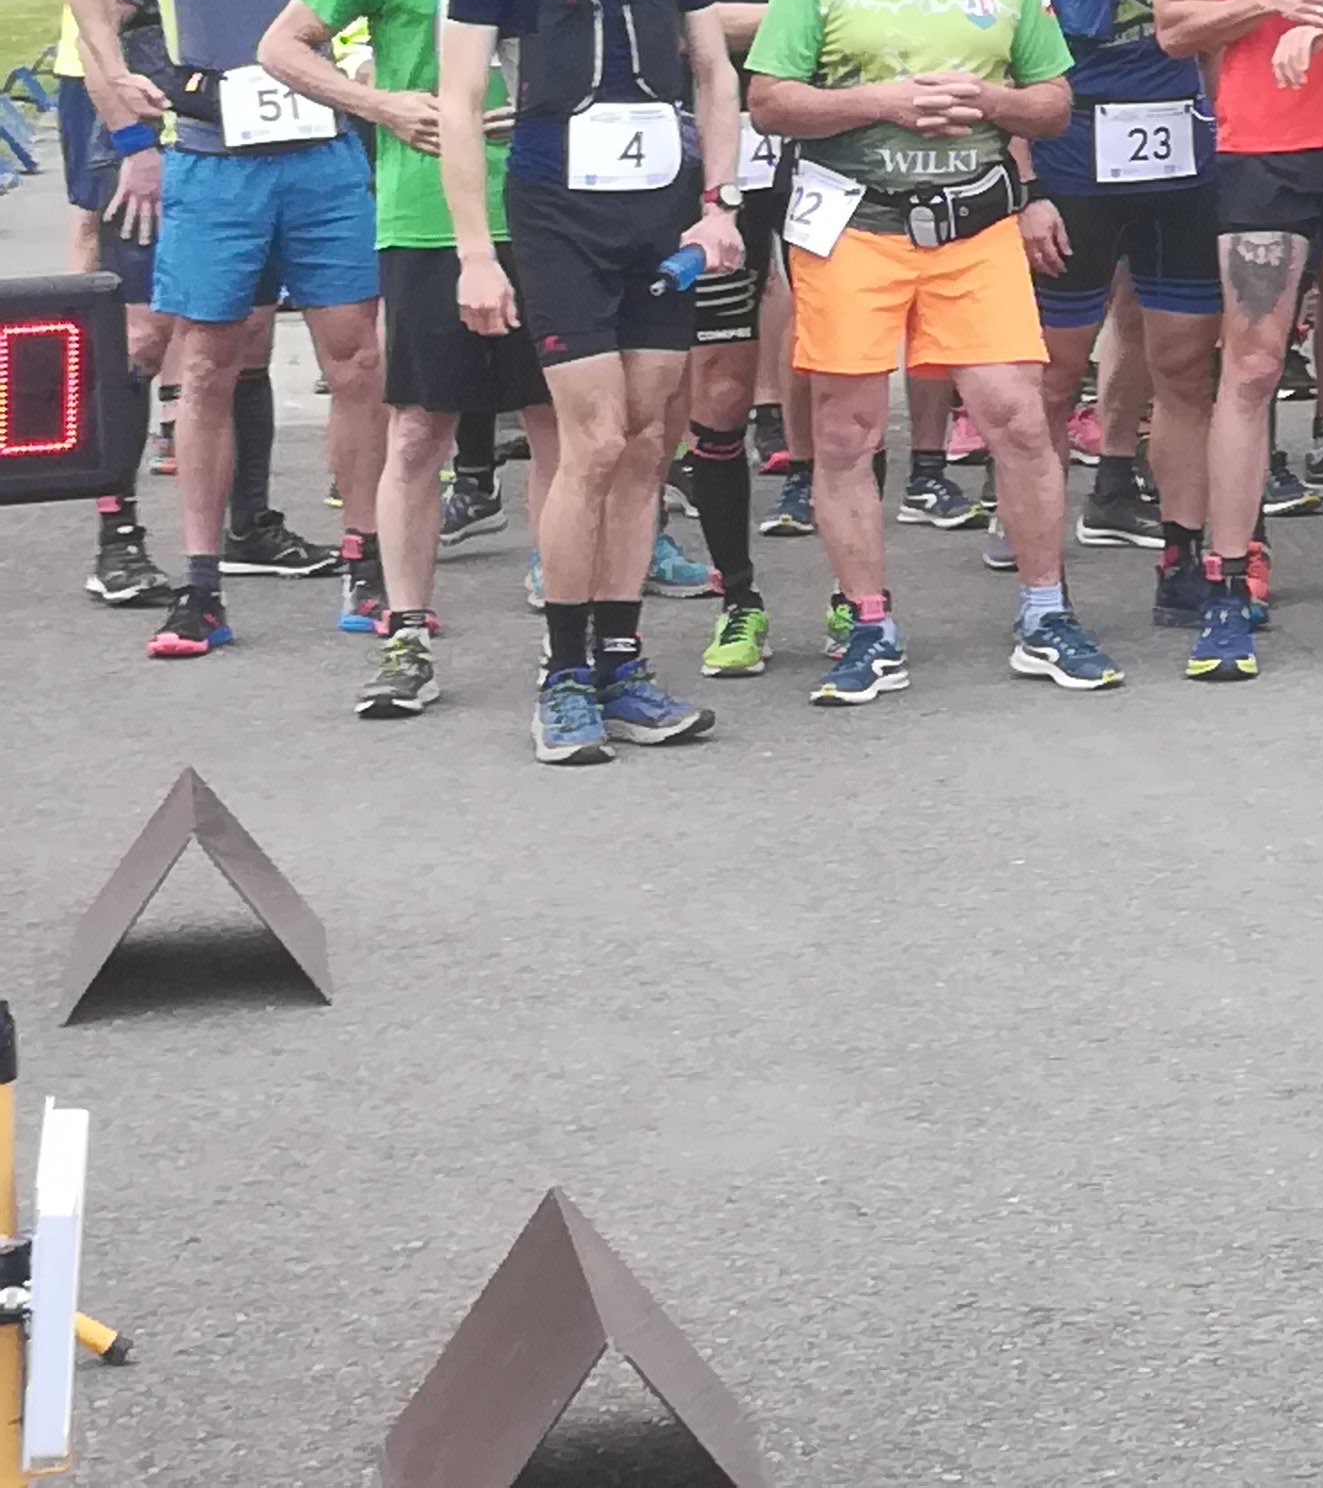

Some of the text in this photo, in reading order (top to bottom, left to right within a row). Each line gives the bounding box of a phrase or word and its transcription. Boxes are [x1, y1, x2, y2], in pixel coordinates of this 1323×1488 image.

[257, 89, 300, 122] 51
[617, 131, 646, 168] 4
[874, 148, 979, 174] WILKI
[1127, 127, 1172, 162] 23
[0, 323, 80, 455] 0
